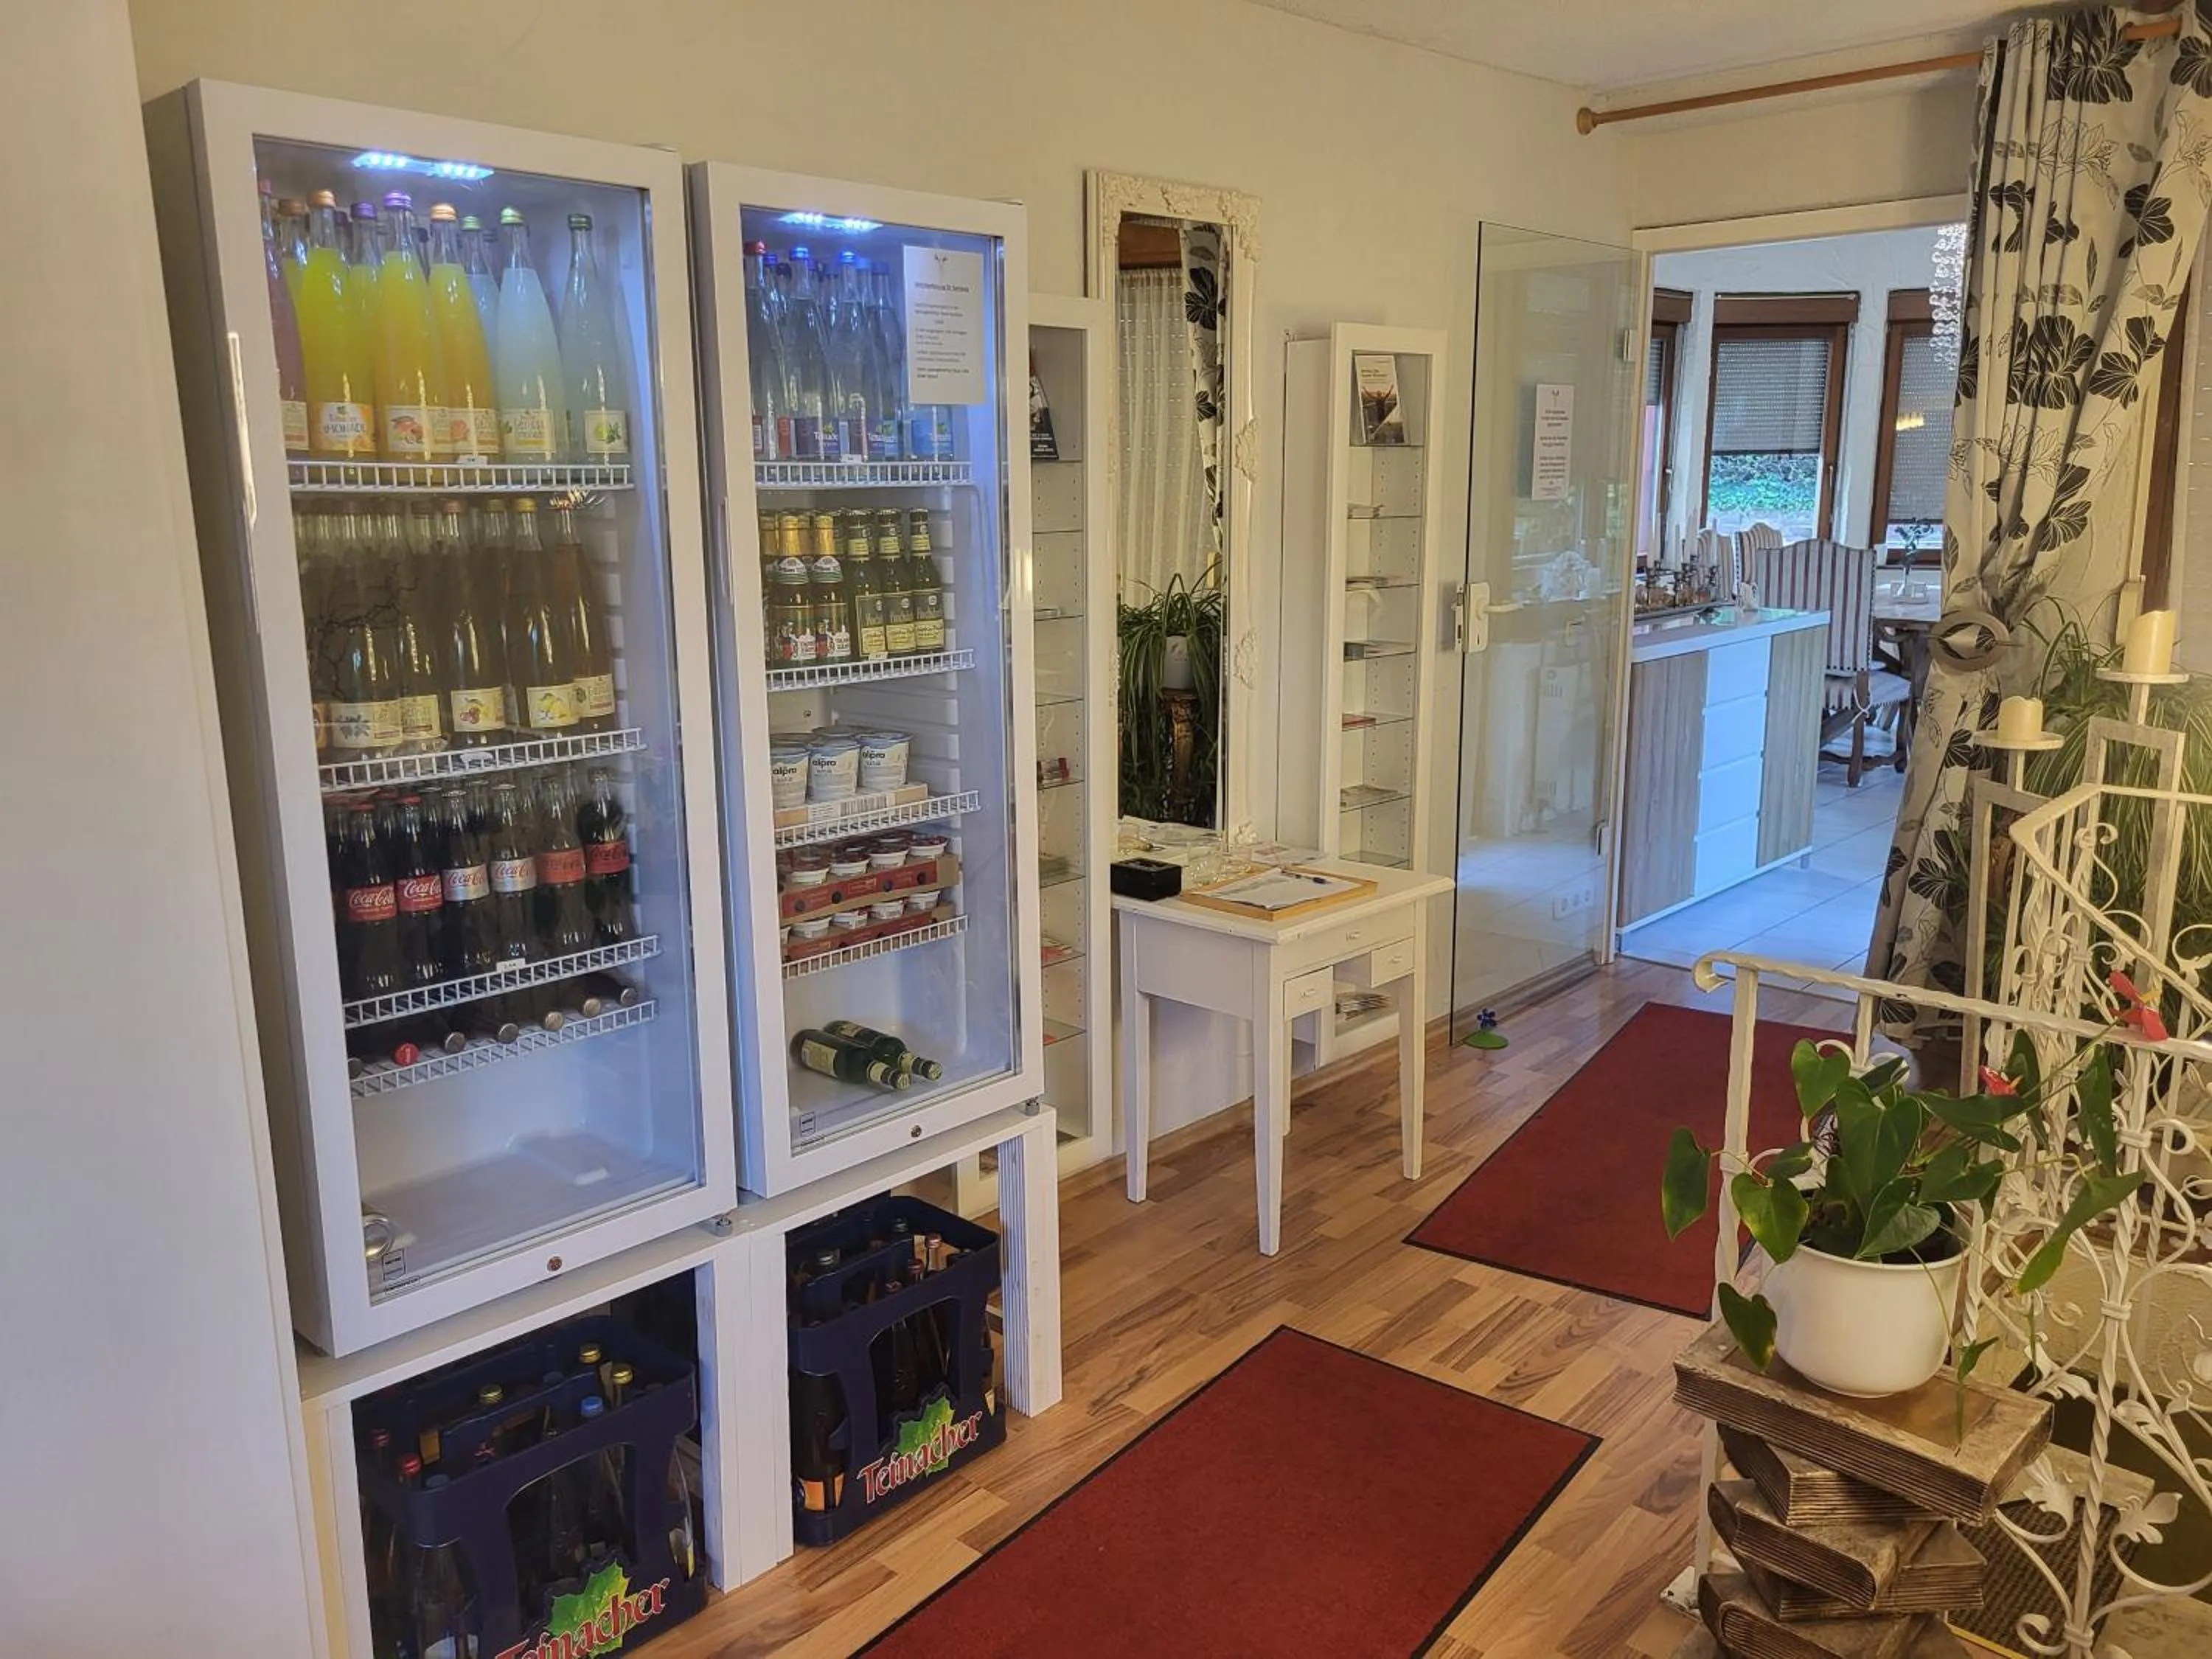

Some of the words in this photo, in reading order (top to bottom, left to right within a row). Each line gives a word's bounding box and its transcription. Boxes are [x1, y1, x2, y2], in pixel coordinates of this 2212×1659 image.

[862, 750, 886, 762] alpro
[813, 757, 837, 770] alpro
[772, 764, 798, 776] alpro
[856, 1411, 983, 1505] Teinacher
